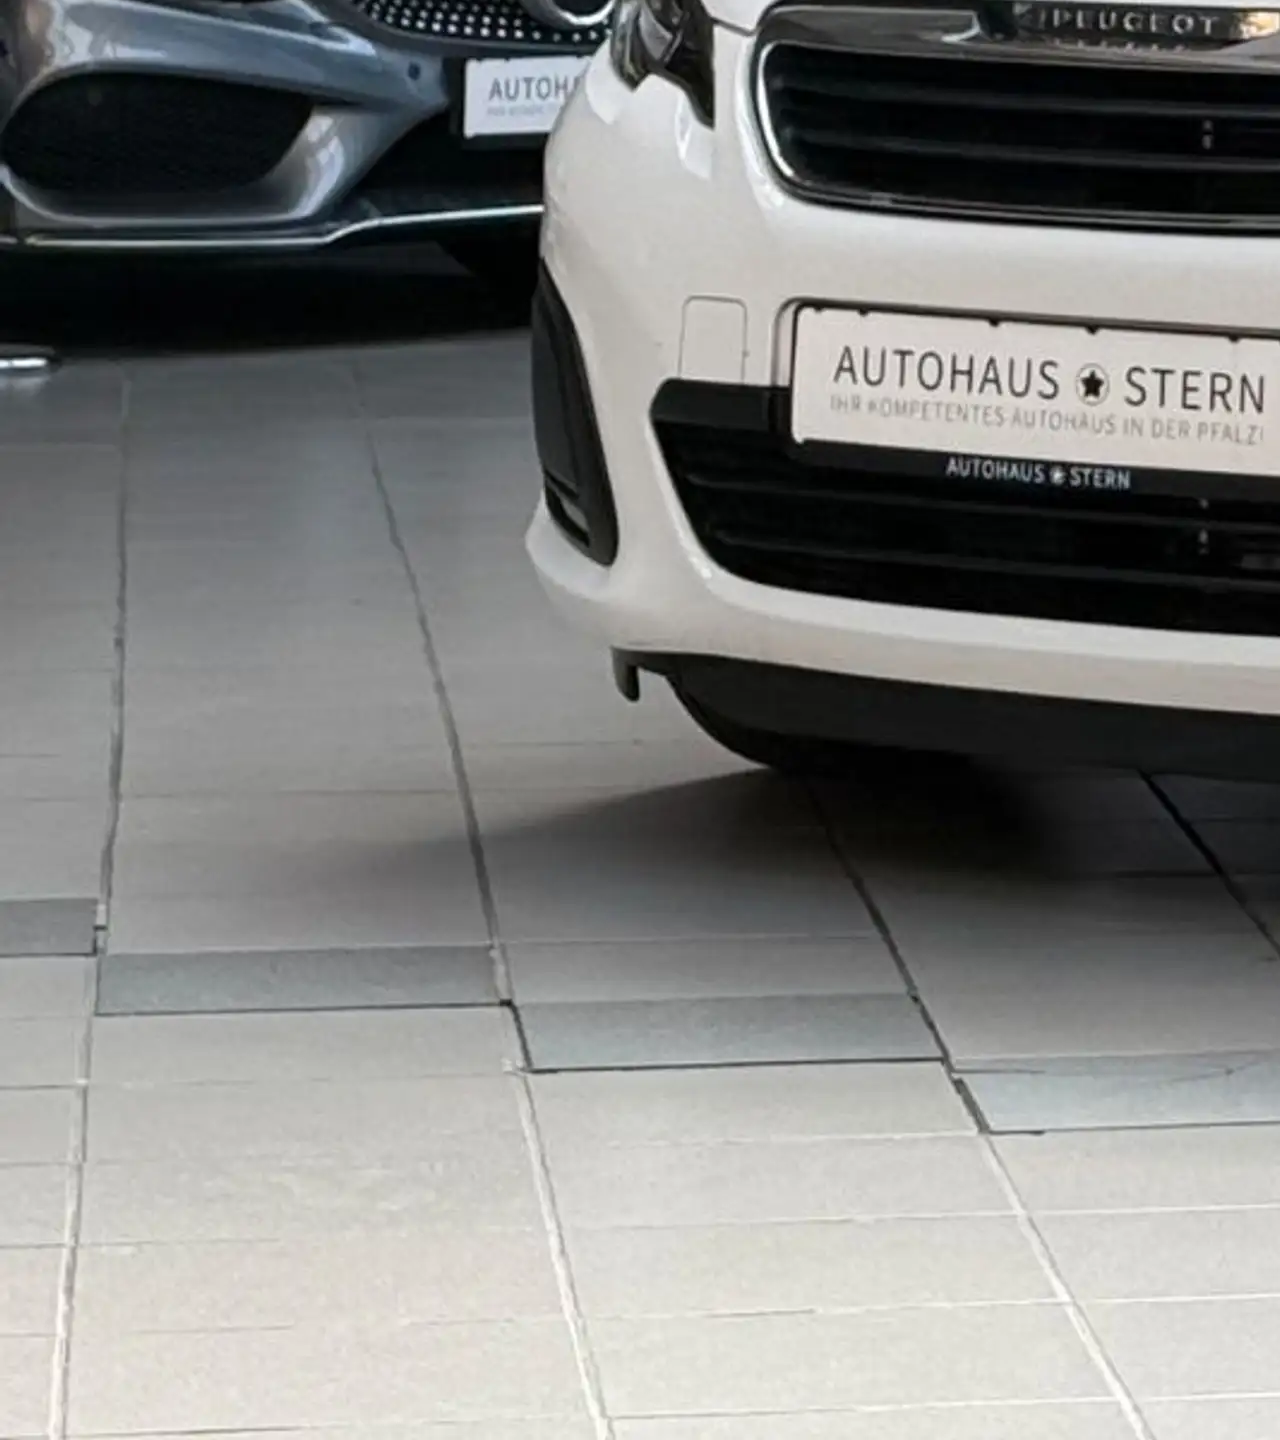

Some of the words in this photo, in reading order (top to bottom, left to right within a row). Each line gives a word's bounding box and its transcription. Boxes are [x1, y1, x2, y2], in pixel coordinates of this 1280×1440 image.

[833, 345, 1060, 399] AUTOHAUS
[1124, 366, 1264, 414] STERN
[830, 395, 861, 413] IHR
[868, 396, 1004, 427] KOMPETENTES
[1009, 410, 1116, 436] AUTOHAUS
[1123, 418, 1144, 437] IN
[1151, 419, 1191, 440] DER
[946, 457, 1045, 484] AUTOHAUS
[1069, 467, 1132, 490] STERN
